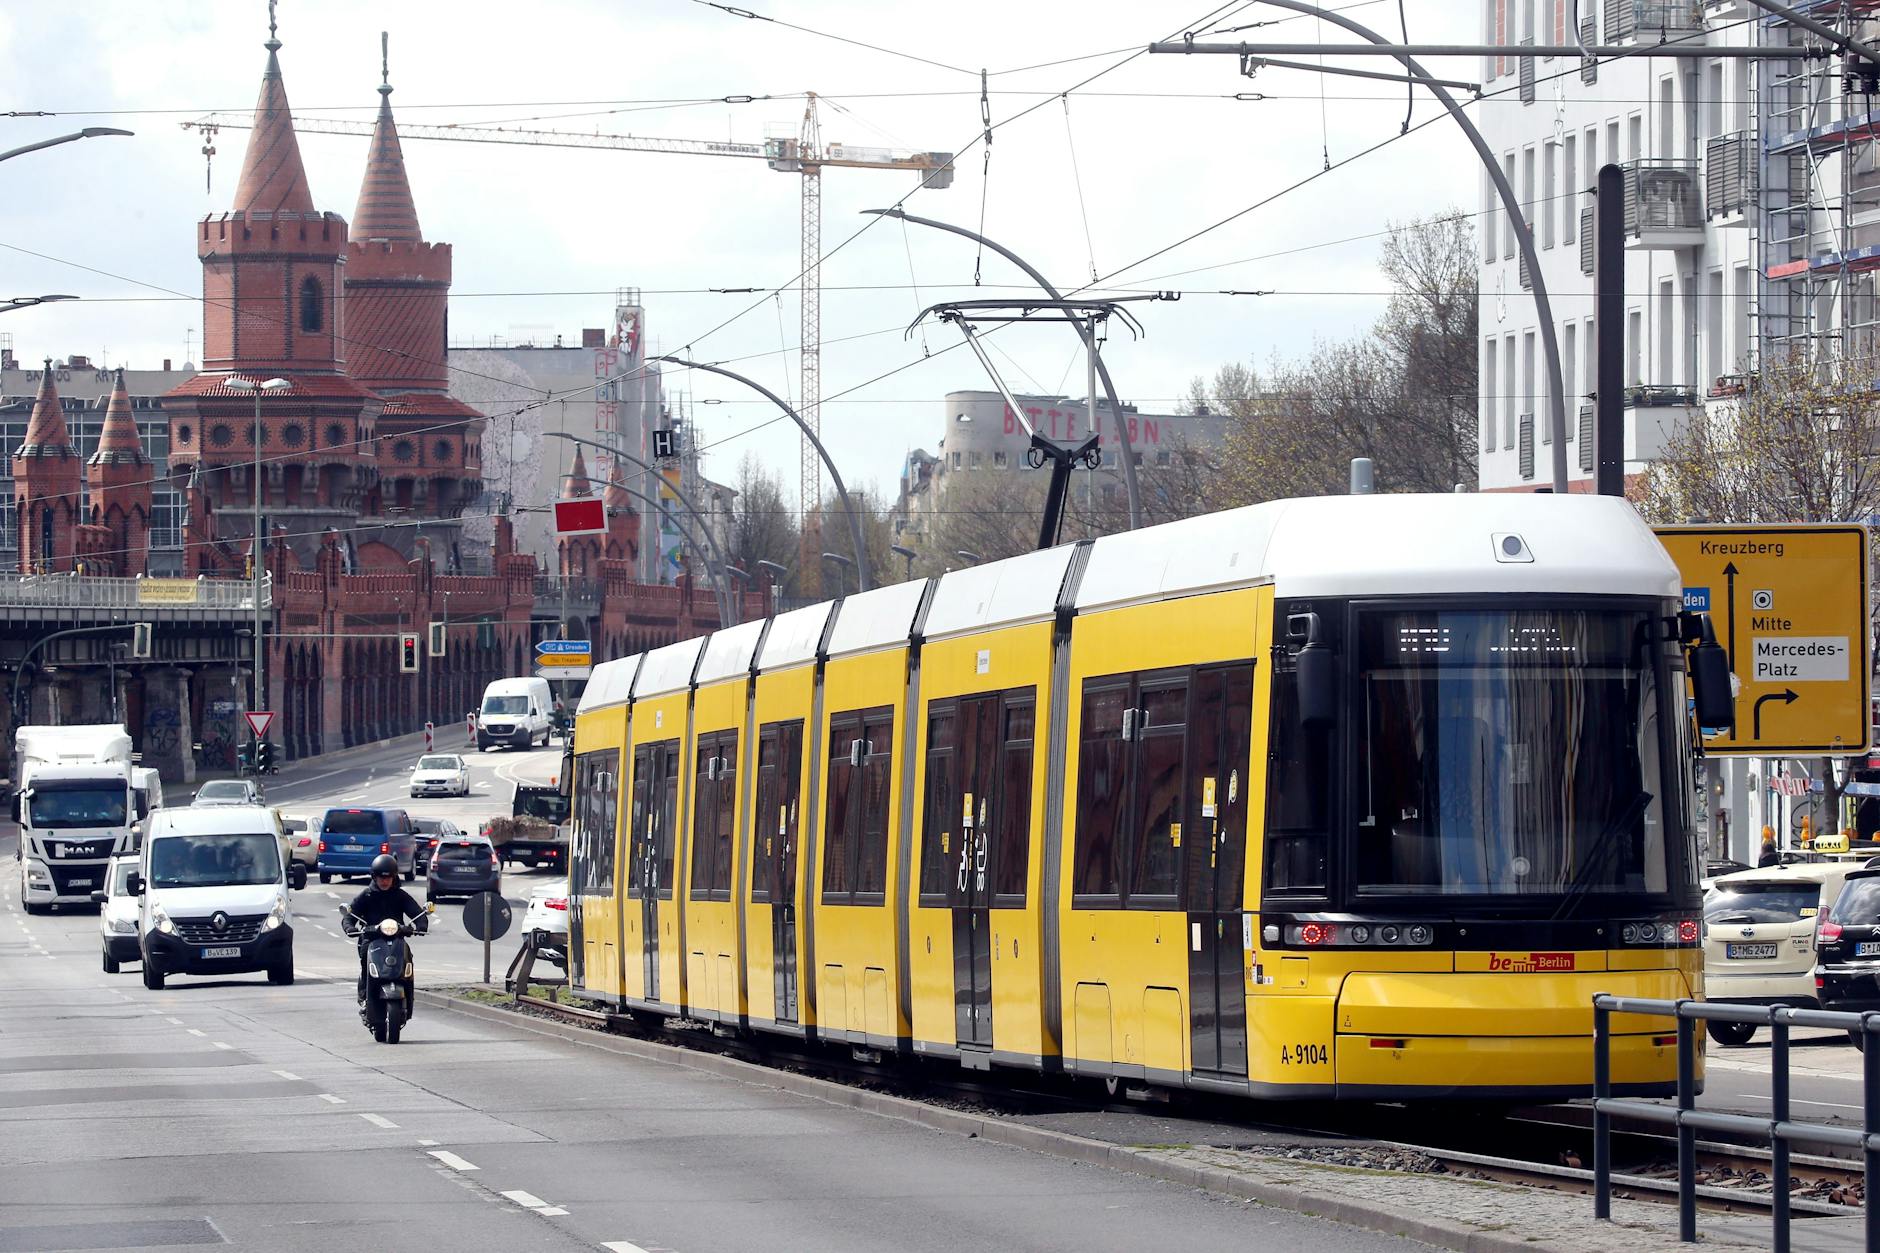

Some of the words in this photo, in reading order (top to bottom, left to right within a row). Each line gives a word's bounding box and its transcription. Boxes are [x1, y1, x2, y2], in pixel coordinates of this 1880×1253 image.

[656, 433, 671, 454] H
[1700, 540, 1784, 557] Kreuzberg
[1752, 617, 1792, 630] Mitte
[1758, 643, 1844, 656] Mercedes-
[1758, 663, 1798, 676] Platz
[64, 846, 95, 854] MAN
[1539, 957, 1570, 968] Berlin
